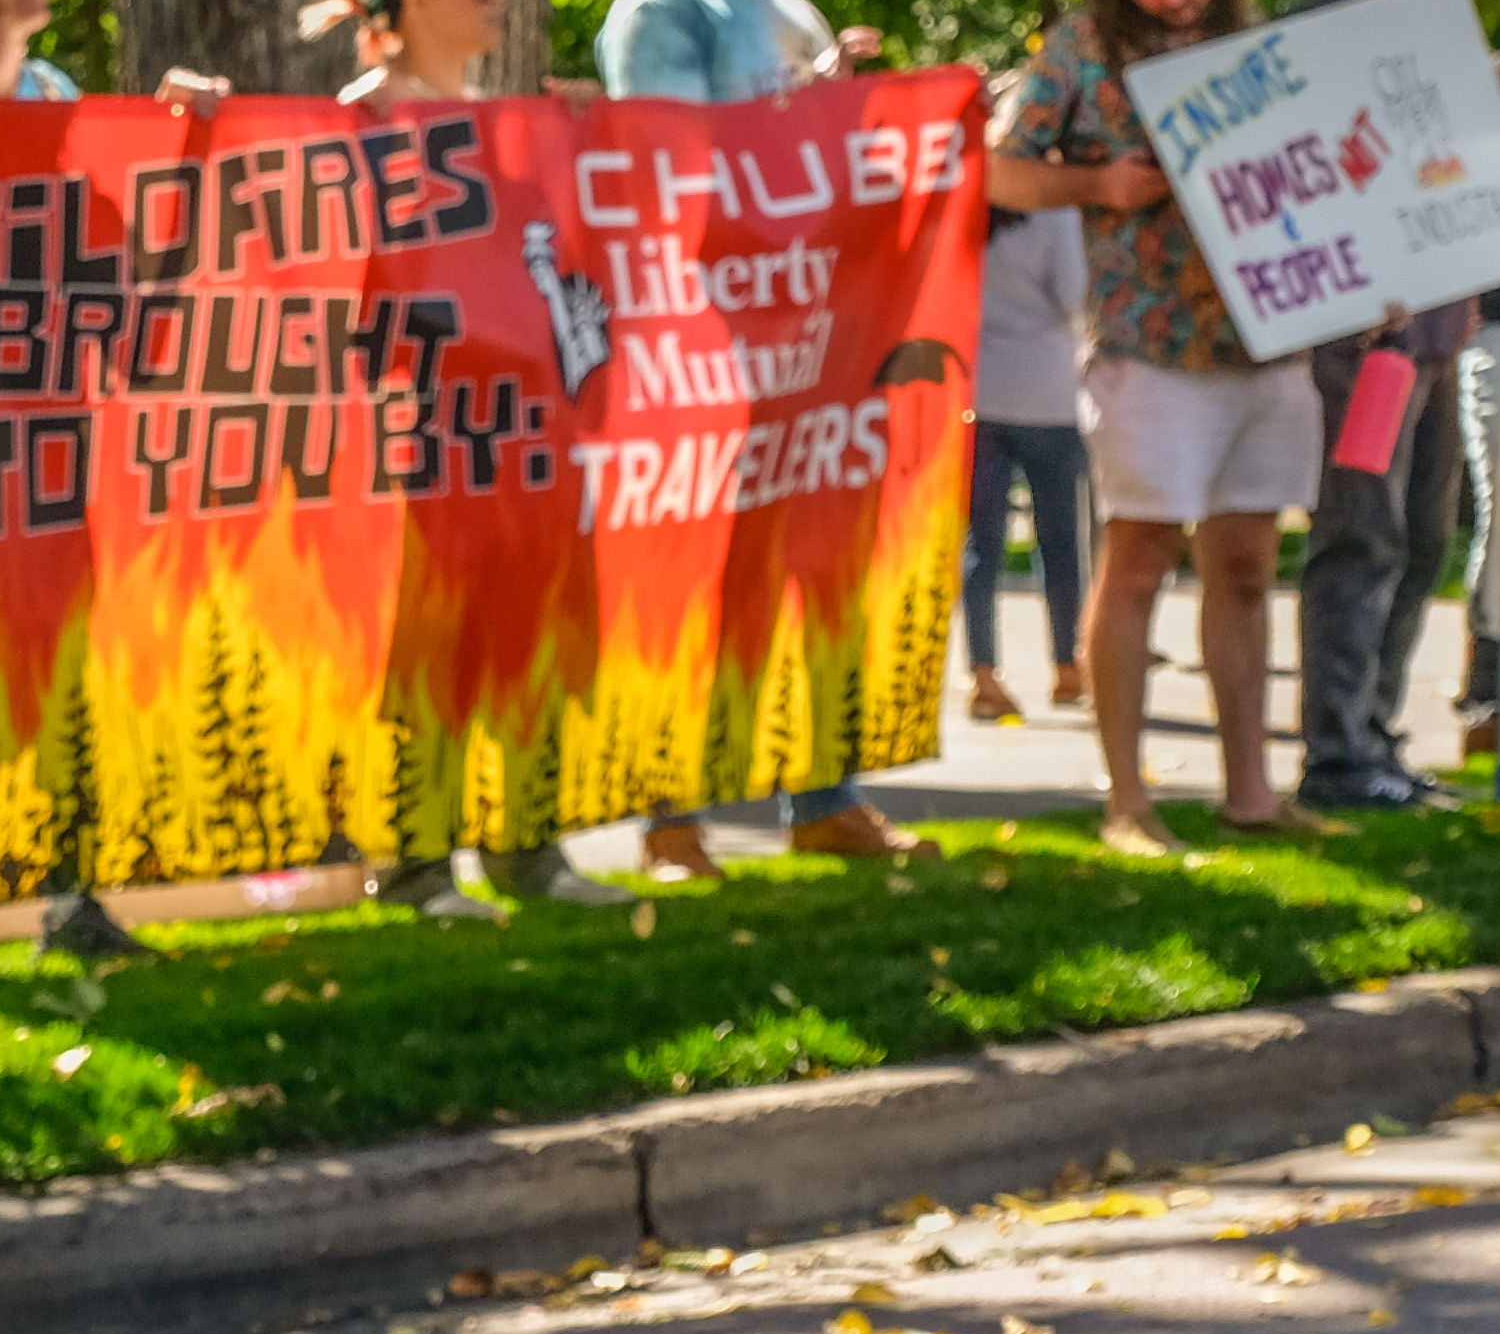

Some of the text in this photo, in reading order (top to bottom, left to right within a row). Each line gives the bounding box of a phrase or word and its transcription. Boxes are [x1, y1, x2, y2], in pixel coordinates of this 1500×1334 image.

[1157, 31, 1309, 177] INSURE
[575, 119, 965, 227] CHUBB
[1208, 130, 1342, 240] HOMES
[605, 233, 840, 319] Liberty
[1234, 234, 1374, 324] PEOPLE
[130, 400, 343, 522] YOU
[568, 396, 889, 536] TRAVELERS
